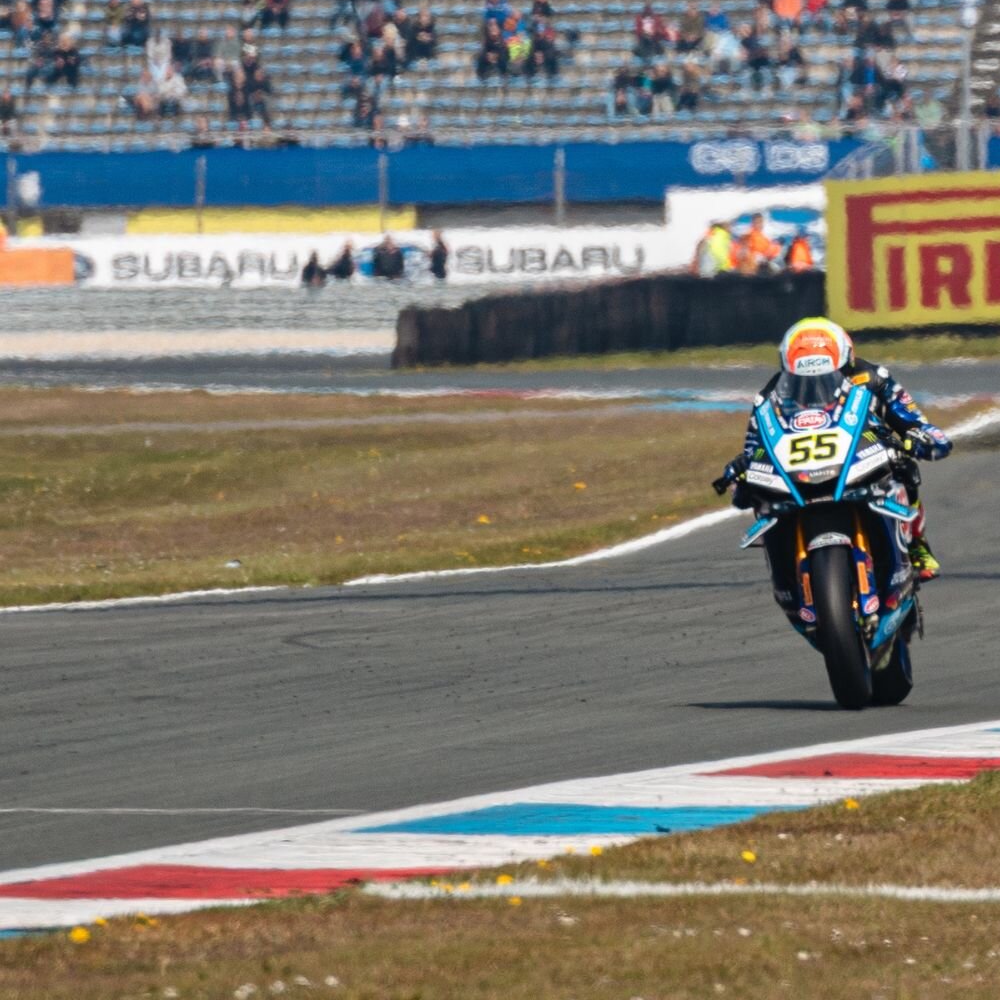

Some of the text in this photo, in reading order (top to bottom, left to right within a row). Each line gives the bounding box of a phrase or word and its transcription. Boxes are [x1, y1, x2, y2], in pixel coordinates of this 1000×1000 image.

[112, 249, 300, 284] SUBARU
[455, 243, 644, 280] SUBARU
[788, 432, 838, 466] 55
